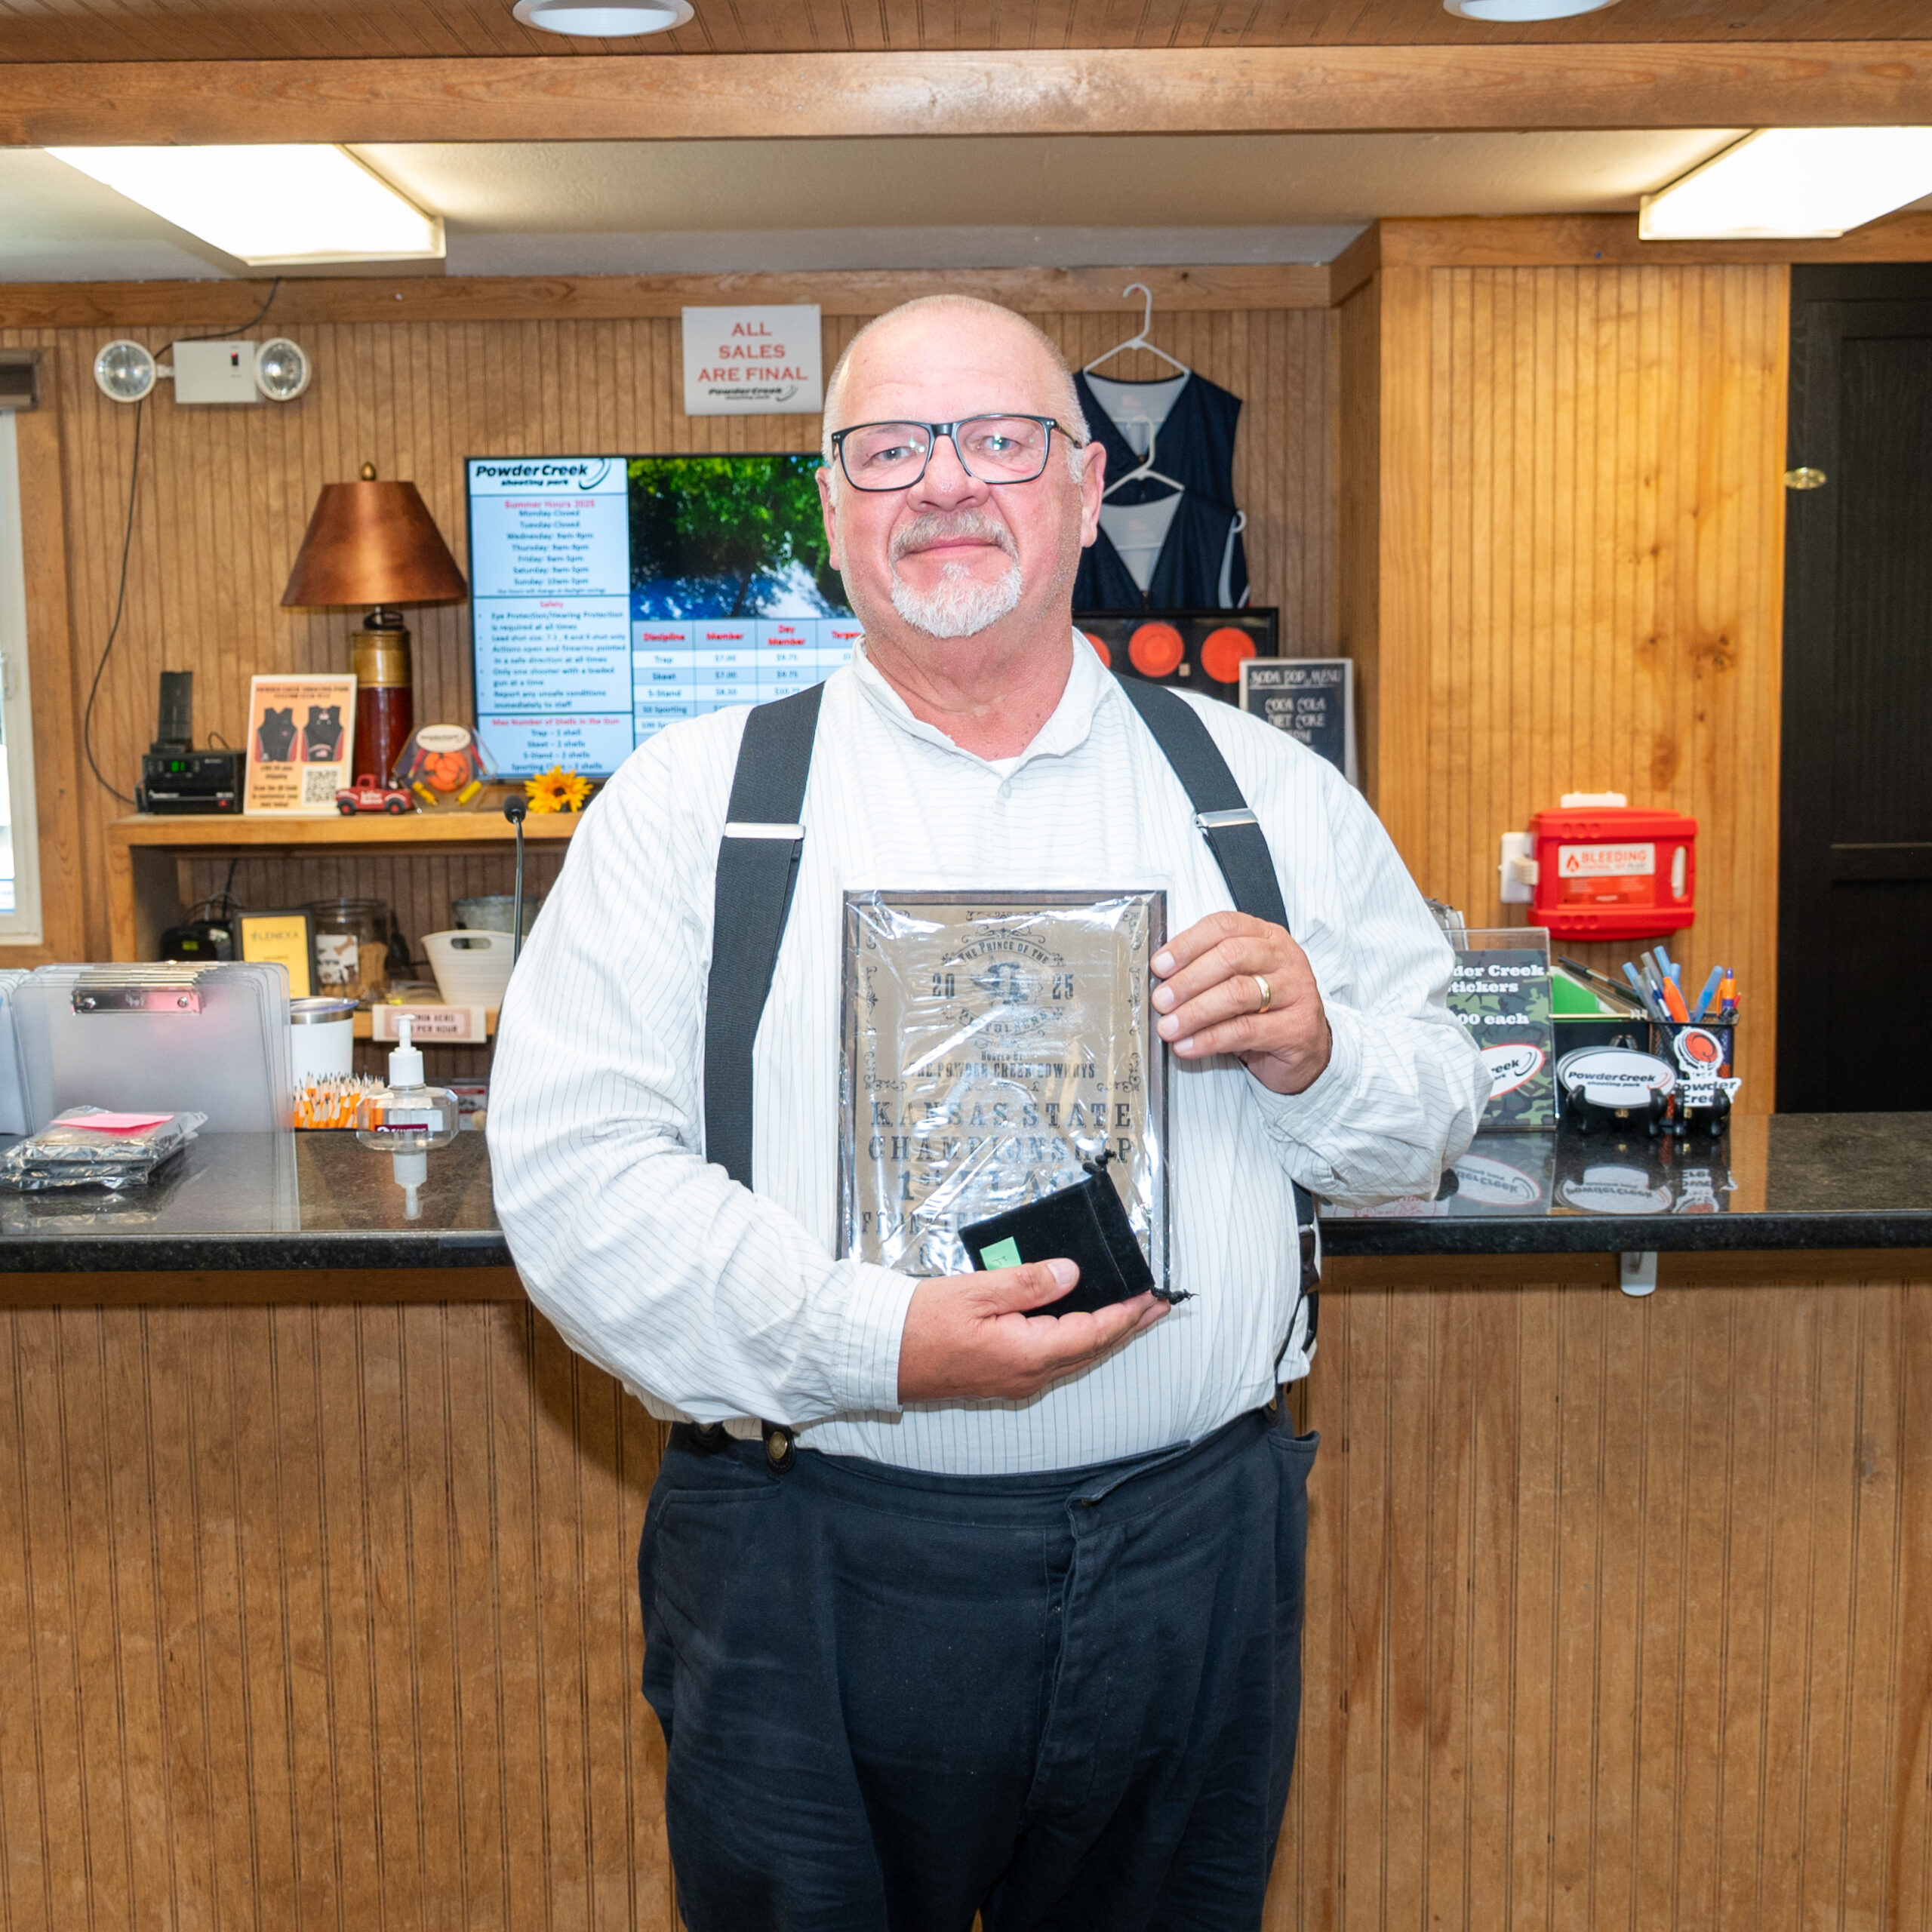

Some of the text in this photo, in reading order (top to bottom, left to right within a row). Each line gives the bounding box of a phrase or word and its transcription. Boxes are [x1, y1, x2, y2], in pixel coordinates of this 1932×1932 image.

[731, 322, 772, 337] ALL
[718, 344, 786, 359] SALES
[697, 366, 808, 382] ARE FINAL
[504, 500, 541, 509] Summer
[643, 632, 685, 641] Discipline
[777, 625, 795, 635] Day
[1265, 697, 1327, 714] COCA COLA
[1295, 712, 1327, 730] COKE
[1581, 850, 1647, 863] BLEEDING
[958, 941, 1050, 964] THE PRINCE OF THE
[1454, 964, 1545, 977] der Creek
[1484, 1014, 1530, 1025] each
[994, 1063, 1031, 1078] CREEK
[1023, 1103, 1132, 1128] STATE
